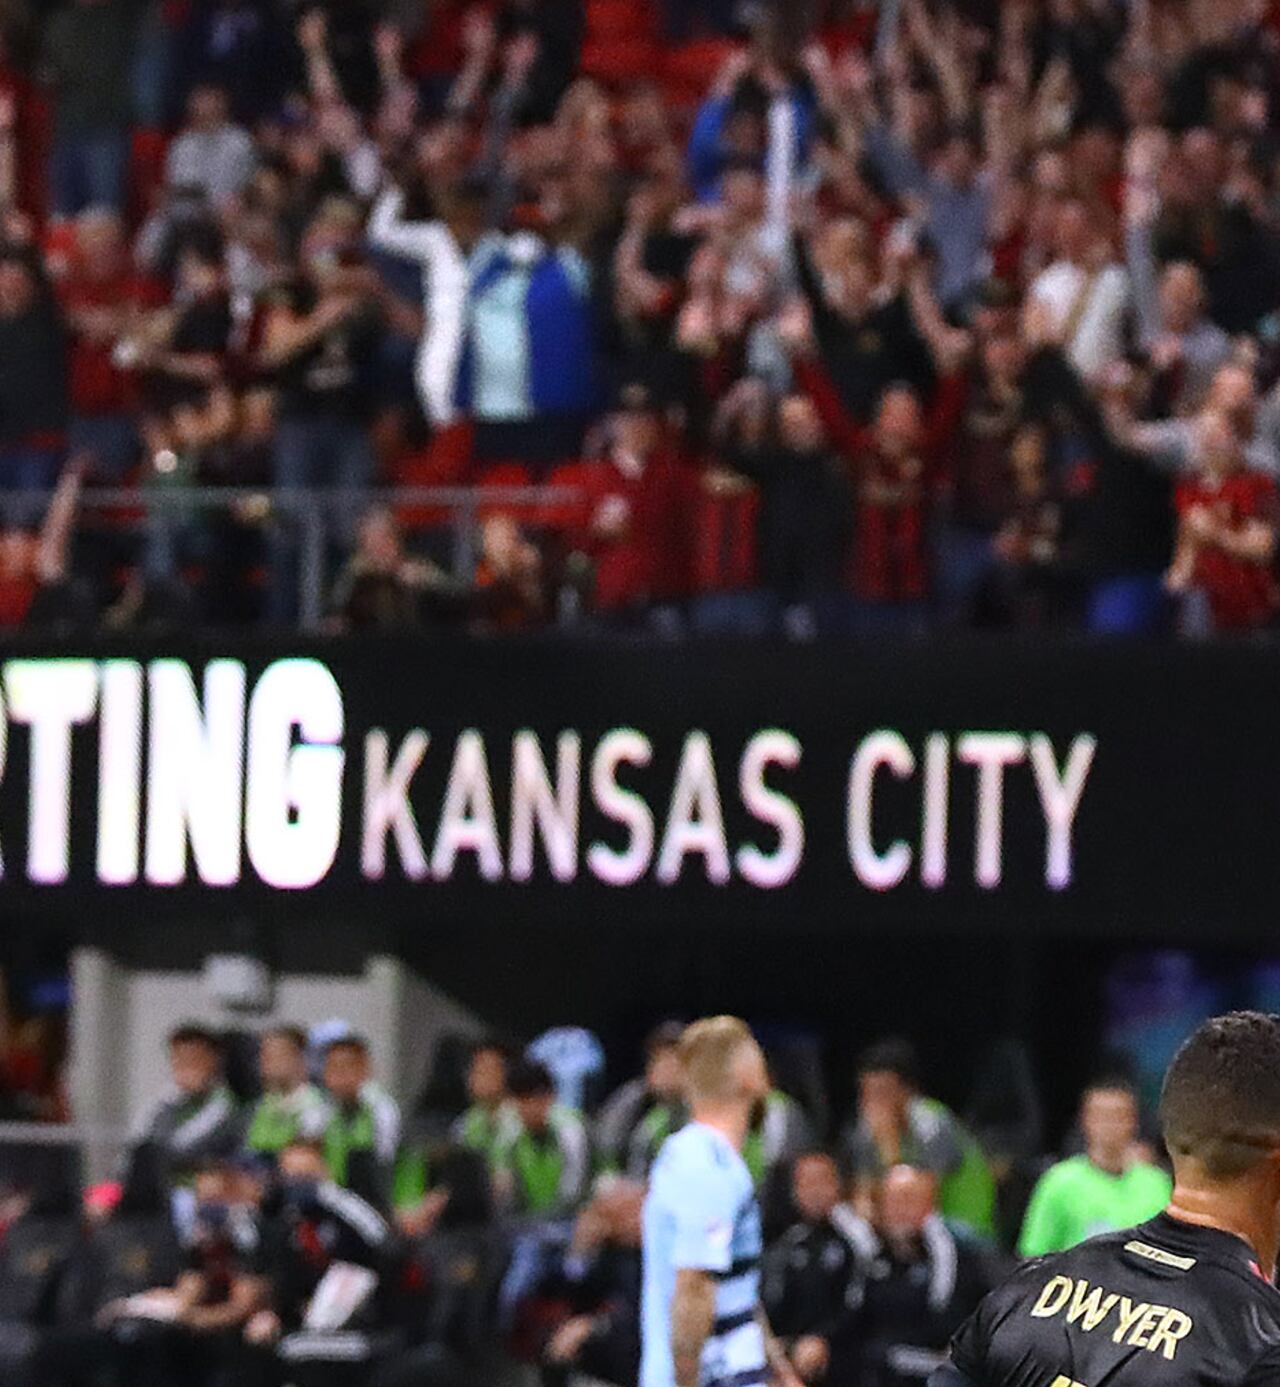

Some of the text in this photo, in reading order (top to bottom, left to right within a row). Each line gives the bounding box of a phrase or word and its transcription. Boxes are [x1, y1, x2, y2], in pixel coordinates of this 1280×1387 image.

[361, 728, 805, 887] KANSAS
[846, 729, 1097, 892] CITY
[1031, 1275, 1193, 1360] DWYER
